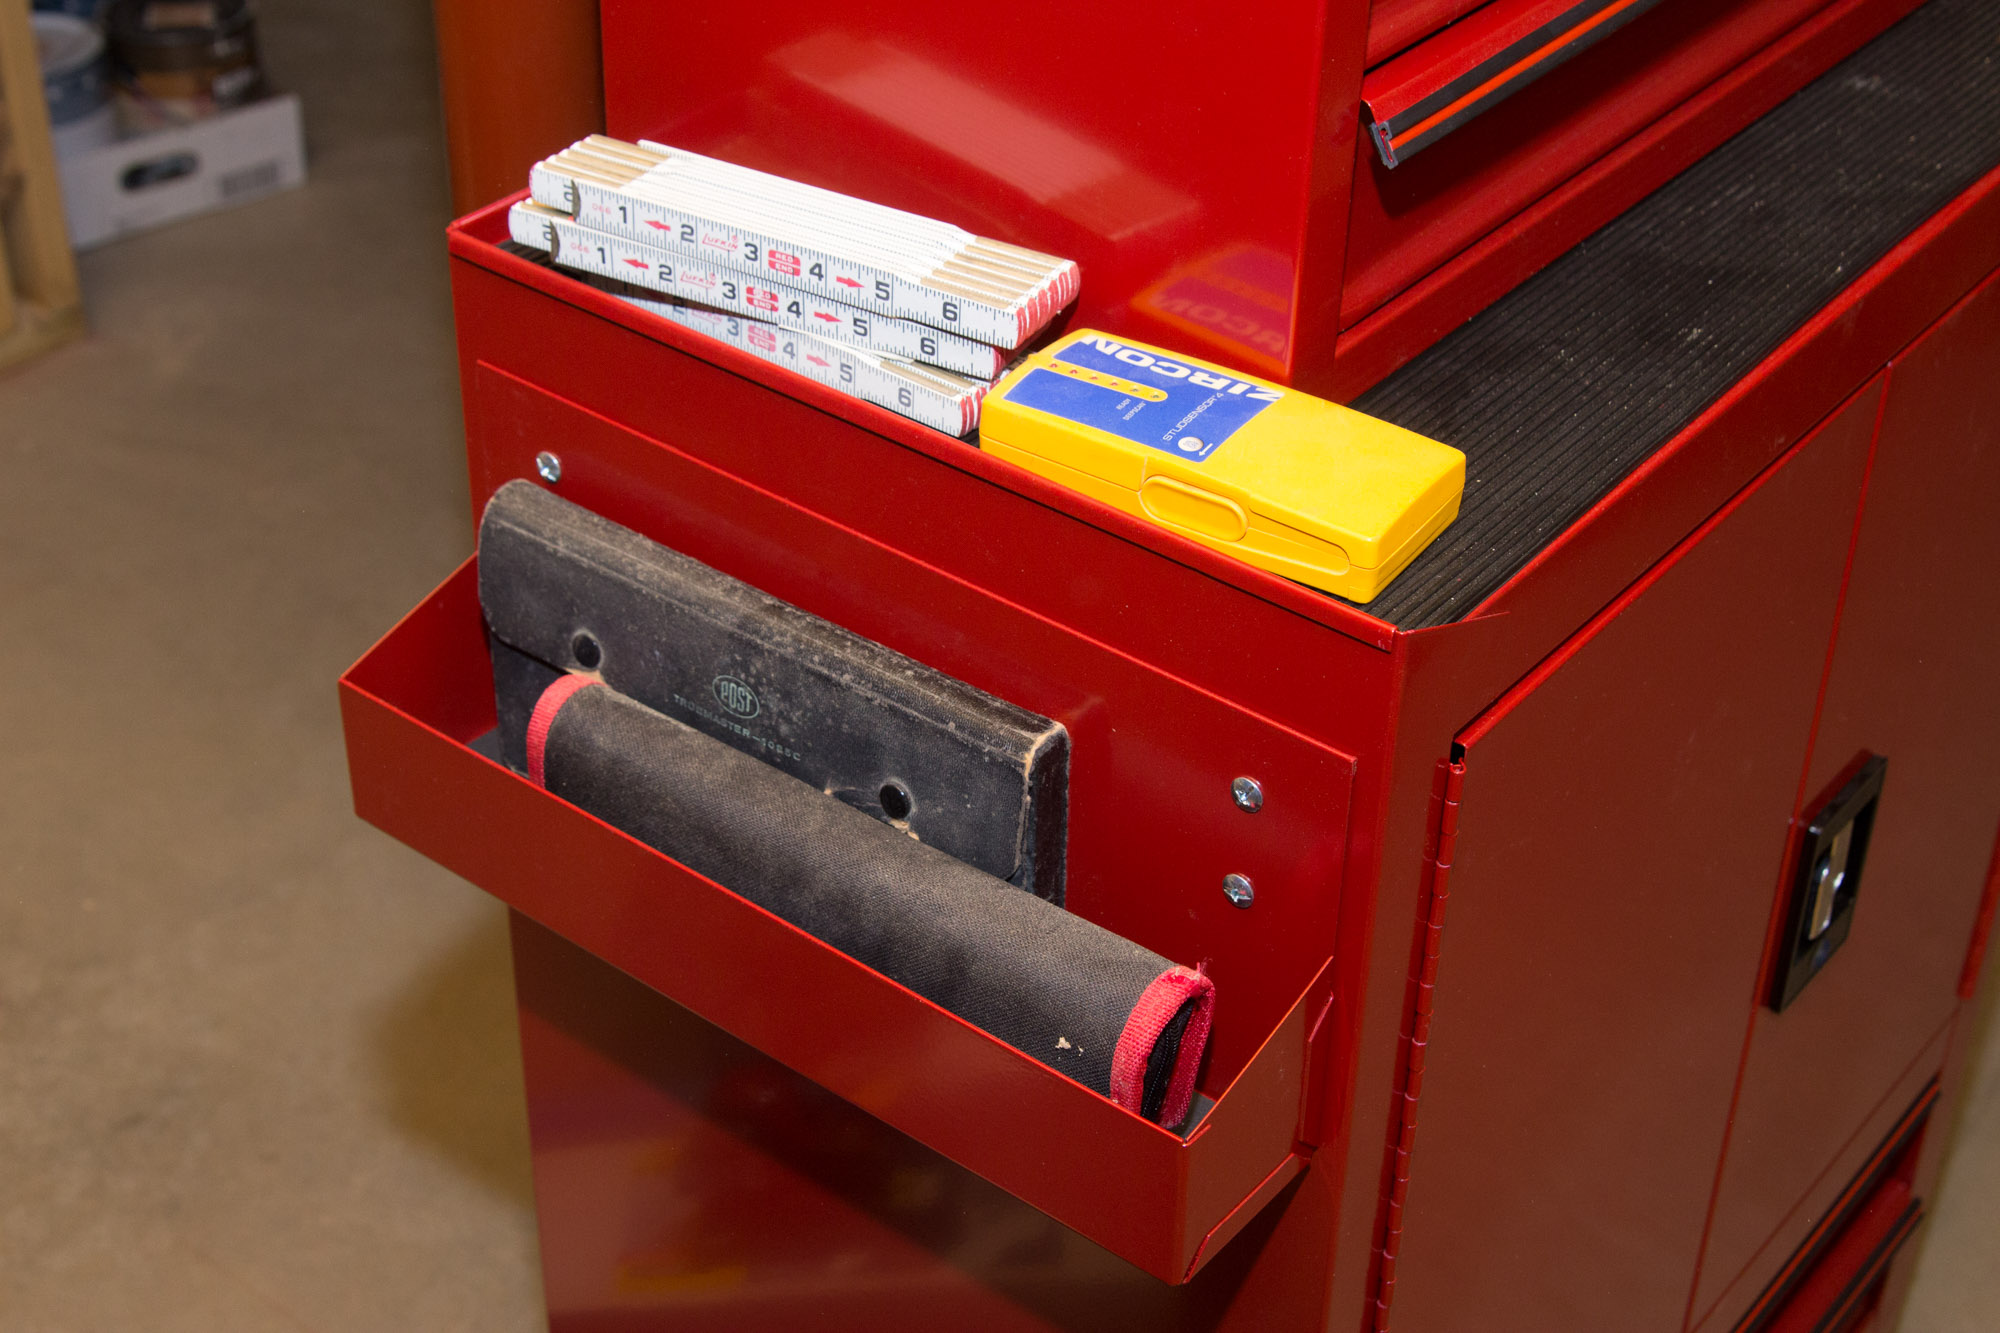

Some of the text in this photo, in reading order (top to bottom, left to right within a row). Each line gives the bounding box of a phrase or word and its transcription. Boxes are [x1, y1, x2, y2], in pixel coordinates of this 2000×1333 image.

[597, 247, 606, 264] 1
[659, 265, 673, 282] 2
[722, 281, 736, 299] 3
[787, 301, 802, 318] 4
[853, 317, 868, 336] 5
[920, 337, 936, 356] 6
[619, 206, 628, 224] 1
[681, 224, 694, 243] 2
[702, 233, 738, 252] LUFKIN
[744, 242, 758, 261] 3
[809, 263, 824, 281] 4
[875, 280, 890, 301] 5
[942, 302, 958, 322] 6
[727, 317, 739, 336] 3
[783, 342, 795, 359] 4
[840, 362, 853, 383] 5
[898, 388, 912, 407] 6
[1080, 334, 1285, 402] ZIRCON
[720, 681, 753, 713] POST
